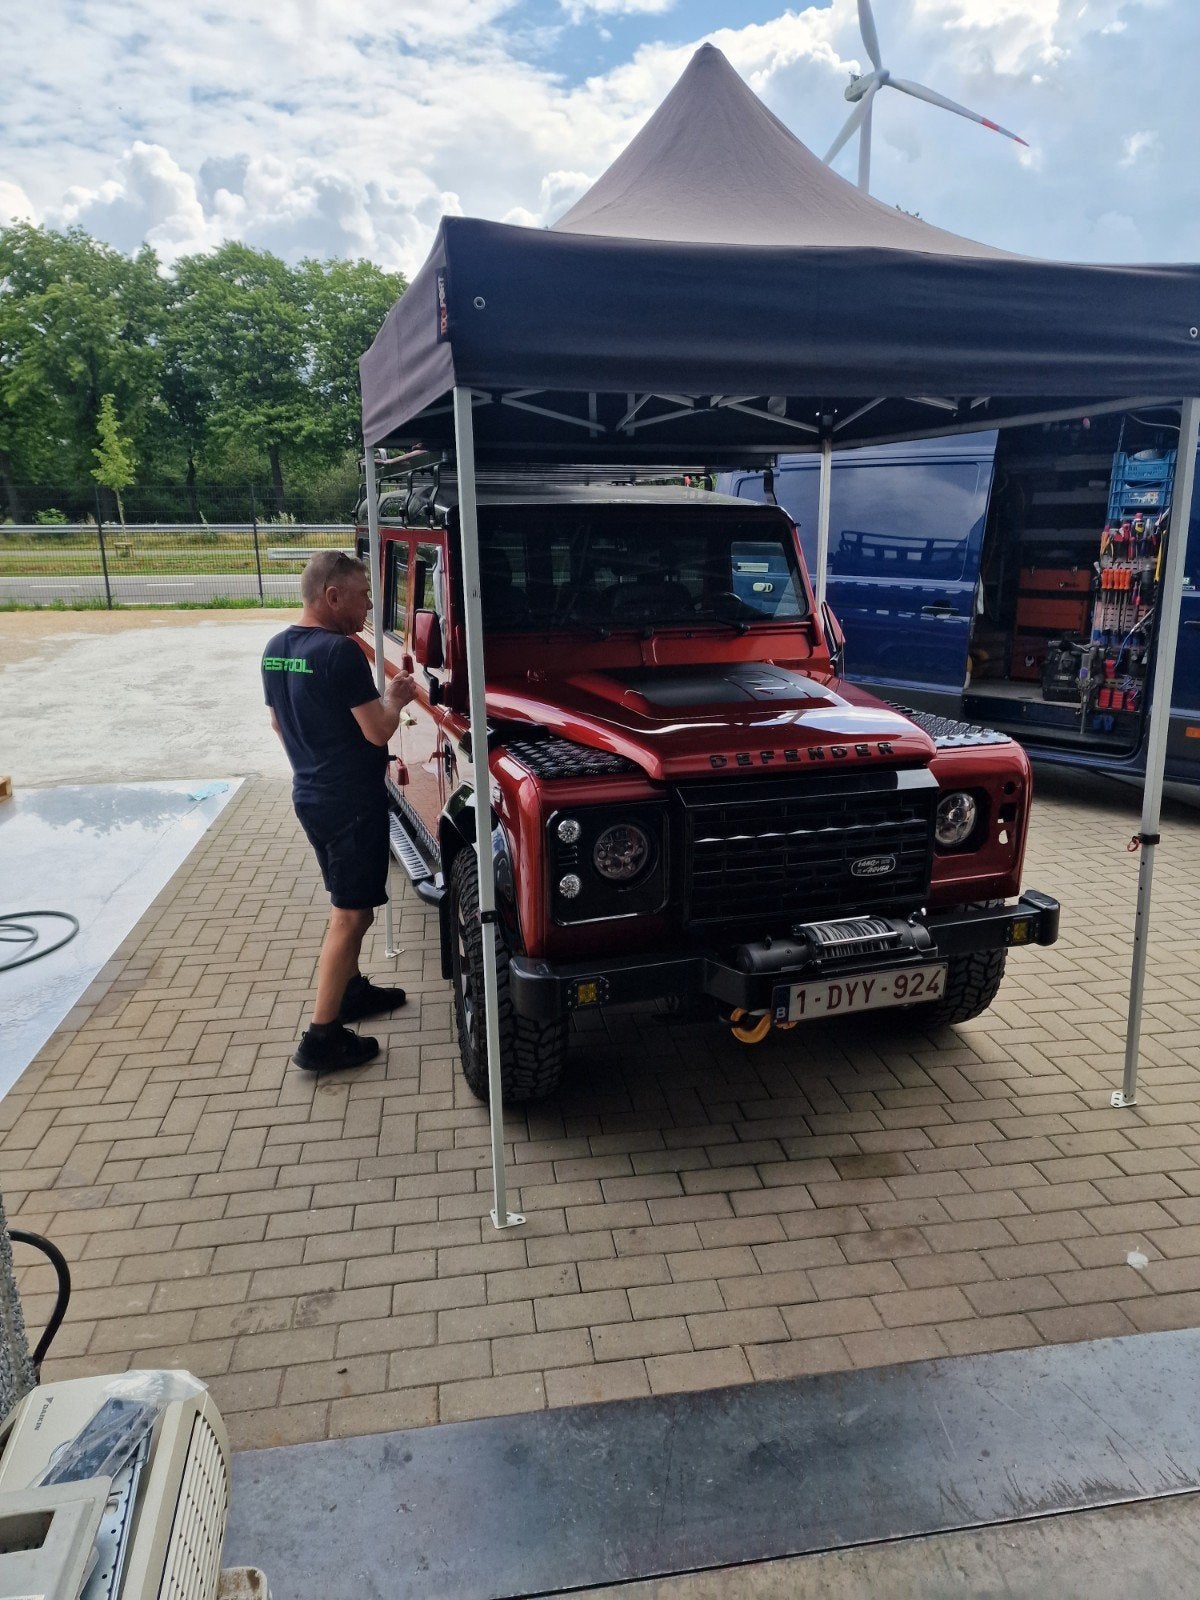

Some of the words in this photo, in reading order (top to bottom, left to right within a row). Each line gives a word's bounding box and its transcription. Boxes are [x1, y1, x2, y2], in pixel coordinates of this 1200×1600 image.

[709, 742, 895, 769] DEFENDER
[776, 1006, 786, 1019] B
[34, 1403, 50, 1431] DAIKIN
